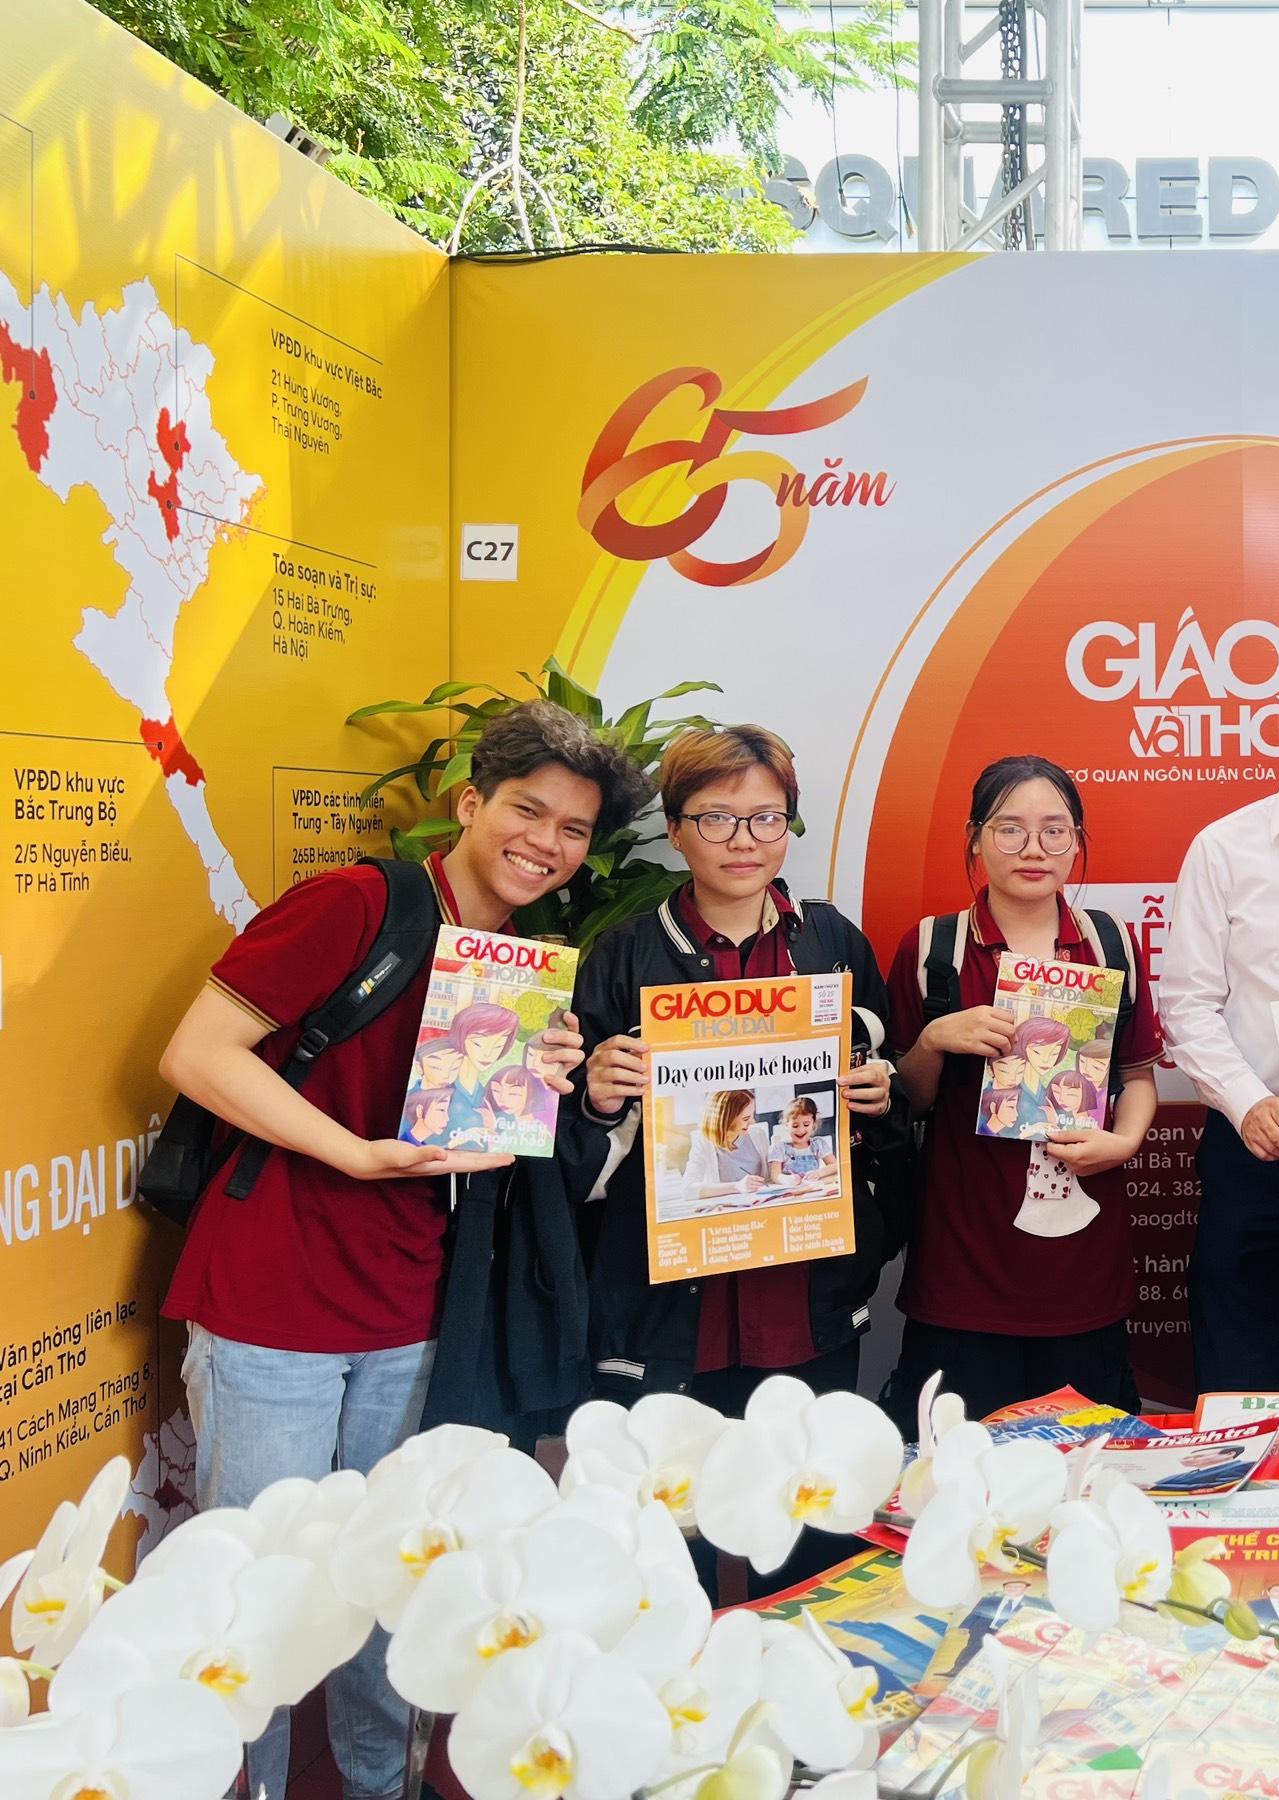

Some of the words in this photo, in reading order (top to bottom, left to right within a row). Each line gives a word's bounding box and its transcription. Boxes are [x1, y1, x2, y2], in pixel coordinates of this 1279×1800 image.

[271, 328, 301, 358] VPĐD
[304, 345, 322, 369] khu
[325, 360, 343, 380] vực
[345, 365, 363, 392] Việt
[271, 369, 281, 387] 21
[776, 457, 897, 507] năm
[466, 541, 514, 563] C27
[273, 553, 294, 577] Tòa
[298, 566, 326, 589] soạn
[329, 570, 341, 590] và
[344, 573, 358, 600] Trị
[273, 588, 284, 606] 15
[287, 590, 304, 611] Hai
[307, 595, 319, 614] Bà
[273, 611, 285, 630] Q.
[289, 614, 315, 636] Hoàn
[273, 634, 287, 654] Hà
[291, 638, 308, 661] Nội
[14, 768, 61, 791] VPĐD
[66, 771, 93, 792] khu
[98, 776, 124, 798] vực
[1092, 769, 1138, 783] QUAN
[1144, 766, 1192, 782] NGÔN
[1196, 765, 1238, 784] LUẬN
[1242, 764, 1276, 780] CỦA
[15, 795, 45, 820] Bắc
[49, 800, 93, 827] Trung
[98, 801, 117, 827] Bộ
[292, 789, 321, 806] VPĐD
[324, 791, 340, 807] các
[292, 812, 321, 834] Trung
[331, 813, 346, 834] Tây
[349, 814, 383, 834] Nguyên
[15, 844, 38, 864] 2/5
[42, 840, 96, 868] Nguyễn
[293, 847, 315, 863] 265B
[318, 846, 345, 866] Hoàng
[15, 874, 33, 893] TP
[38, 873, 56, 892] Hà
[60, 872, 89, 891] Tĩnh
[456, 936, 514, 966] GIÁO
[516, 947, 560, 974] DỤC
[1014, 962, 1064, 986] GIÁO
[1065, 970, 1106, 993] DỤC
[650, 988, 730, 1021] GIÁO
[735, 986, 797, 1019] DỤC
[657, 1064, 690, 1088] Dạy
[694, 1066, 724, 1082] con
[728, 1059, 755, 1088] lập
[759, 1055, 778, 1076] kế
[781, 1050, 832, 1078] hoạch
[1149, 1151, 1172, 1168] Bà
[48, 1145, 105, 1236] ĐẠI
[32, 1322, 81, 1363] phòng
[86, 1309, 112, 1335] liên
[116, 1300, 136, 1324] lạc
[58, 1348, 86, 1375] Thơ
[17, 1414, 54, 1441] Cách
[59, 1391, 96, 1422] Mạng
[100, 1374, 139, 1401] Tháng
[20, 1440, 51, 1472] Ninh
[123, 1392, 147, 1418] Thơ
[1225, 1424, 1260, 1438] tra
